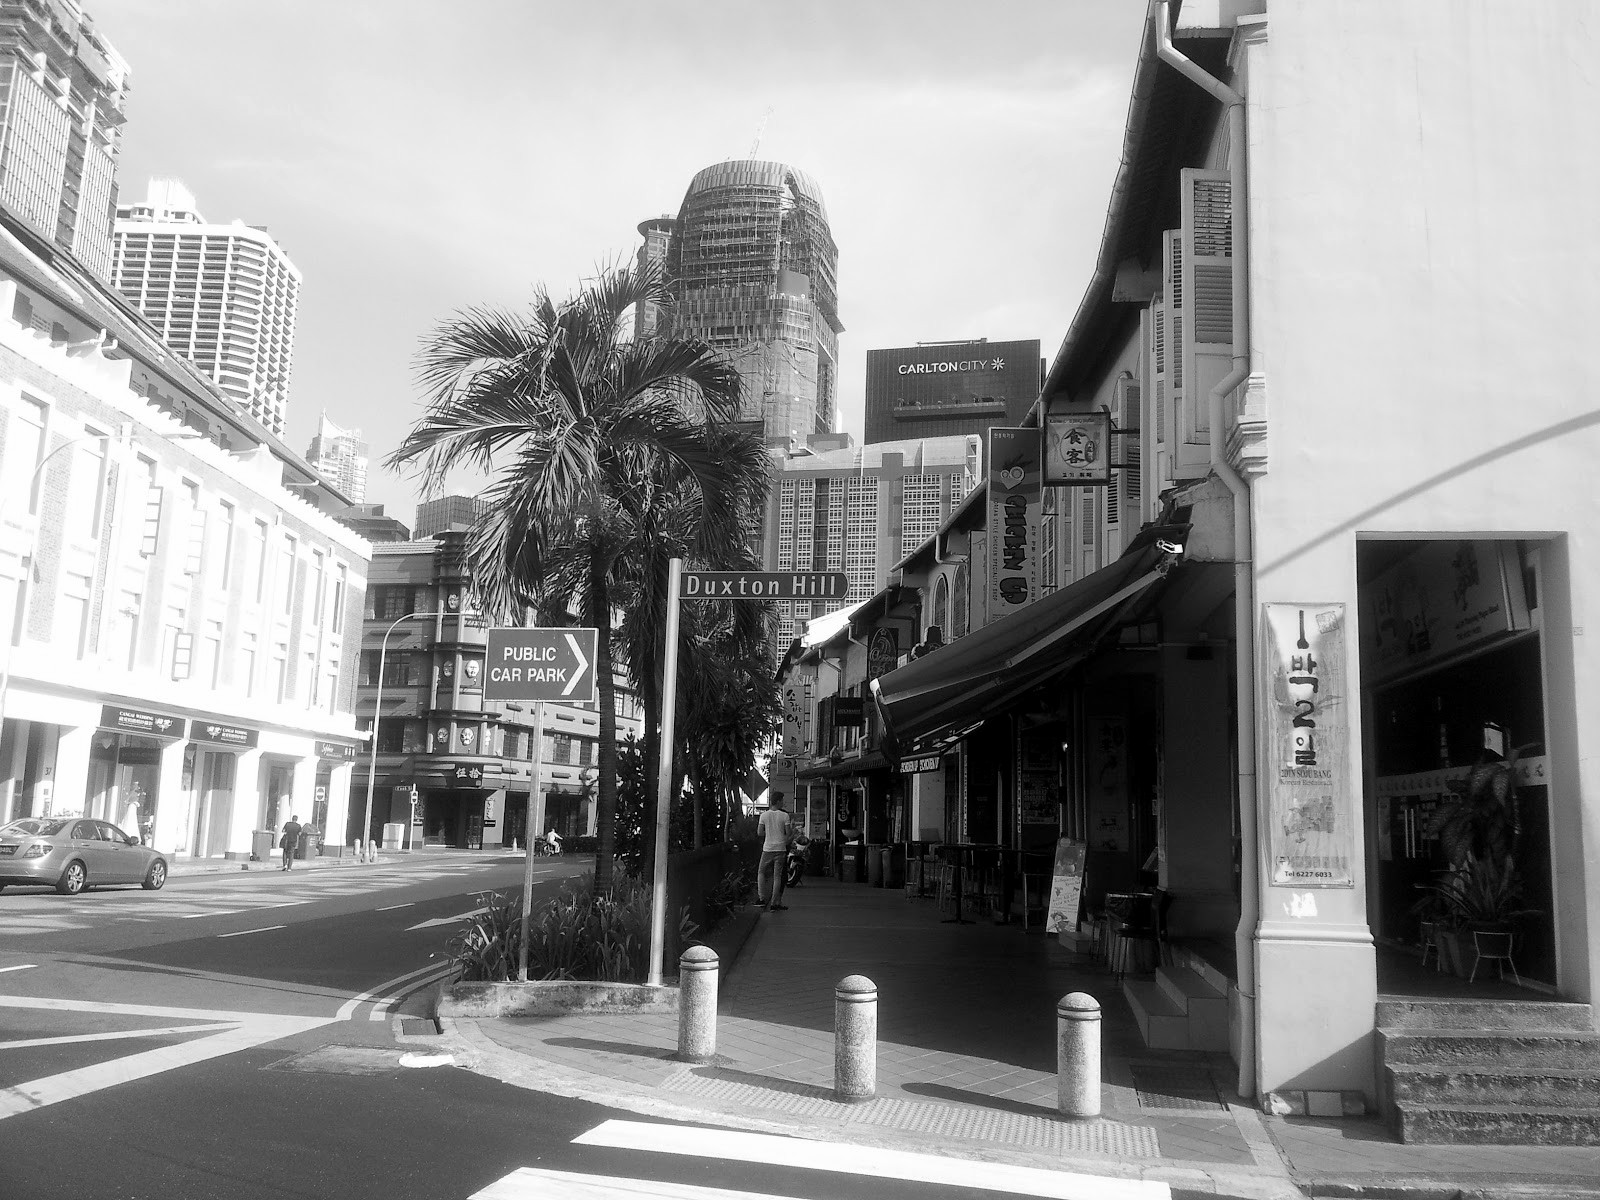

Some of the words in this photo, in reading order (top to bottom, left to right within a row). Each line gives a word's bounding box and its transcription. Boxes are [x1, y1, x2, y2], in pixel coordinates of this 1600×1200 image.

[1002, 495, 1027, 571] CHICKEN
[686, 575, 780, 595] Duxton
[791, 575, 836, 595] Hill
[1000, 576, 1028, 605] UP
[503, 646, 557, 662] PUBLIC
[491, 667, 522, 682] CAR
[527, 667, 567, 682] PARK
